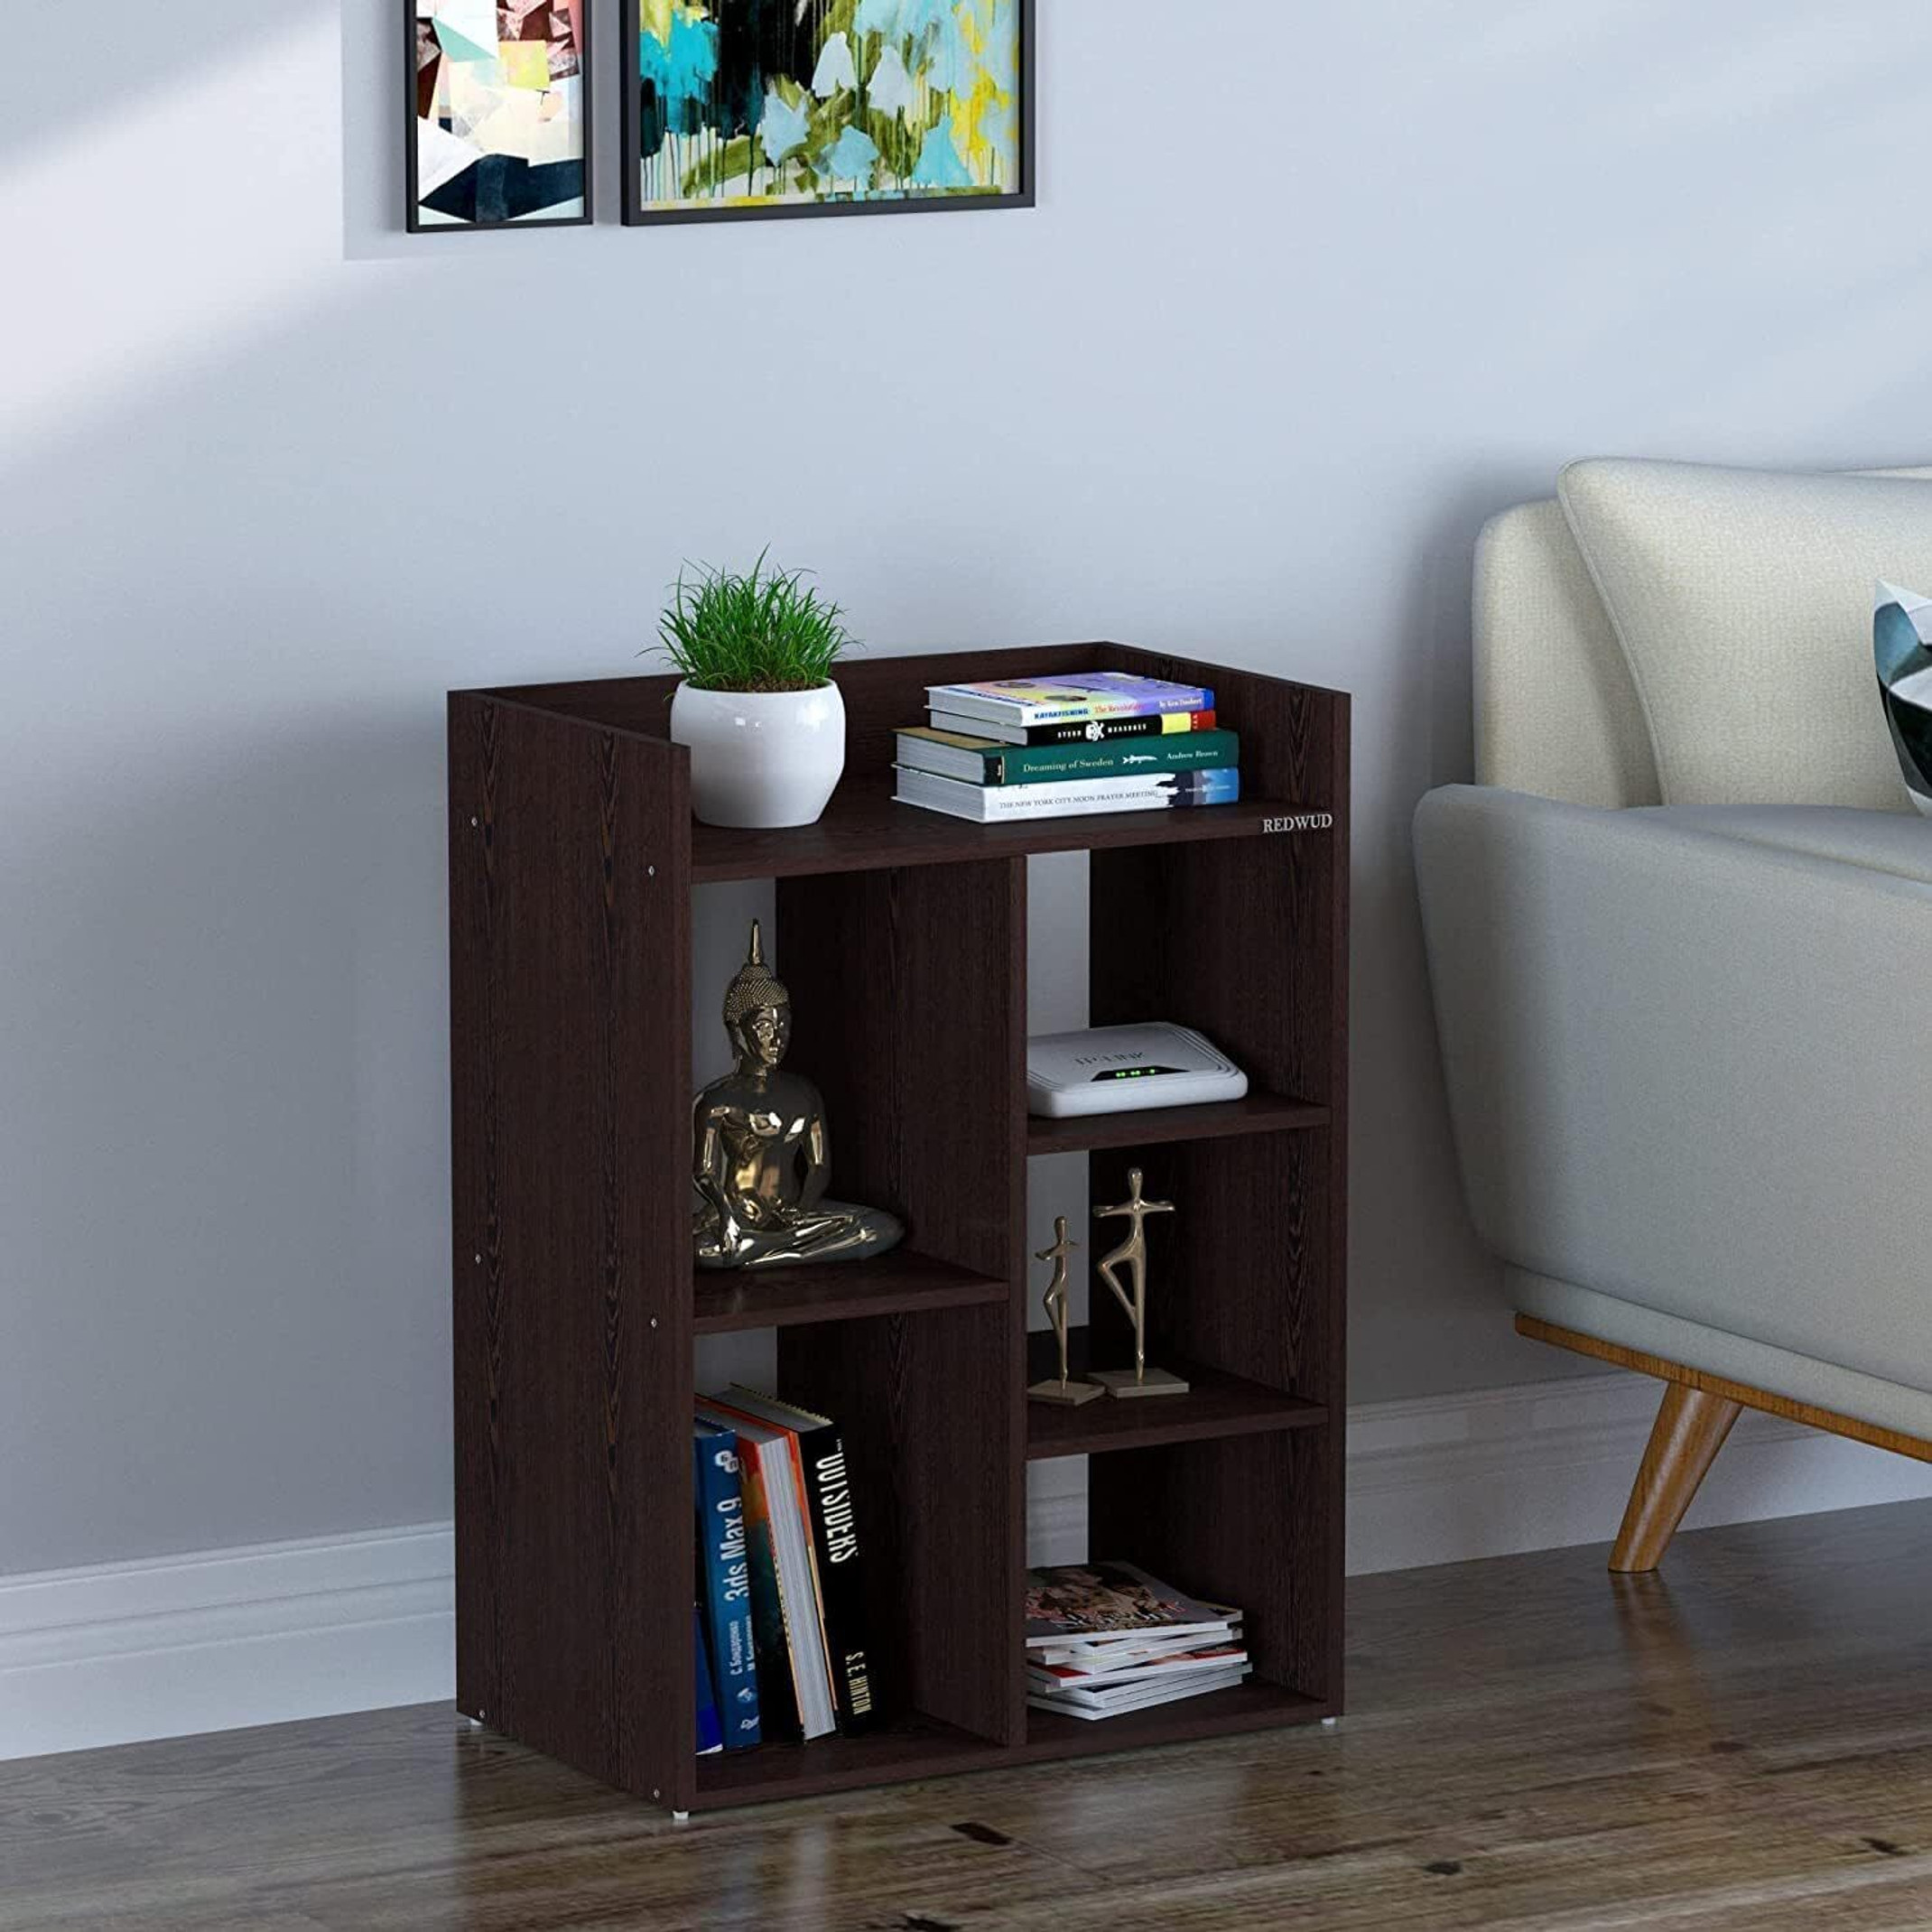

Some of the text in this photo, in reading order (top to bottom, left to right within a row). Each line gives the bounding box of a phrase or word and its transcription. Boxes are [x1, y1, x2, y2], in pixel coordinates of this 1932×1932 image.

[1023, 749, 1219, 773] Dreaming of Sweden Andrew Brown
[999, 789, 1157, 810] THE NEW YORK CITY NOON PRAYER MEETING
[1262, 813, 1333, 833] REDWUD
[716, 1496, 749, 1602] 3ds Max 9
[845, 1651, 872, 1715] S. E. HINTON
